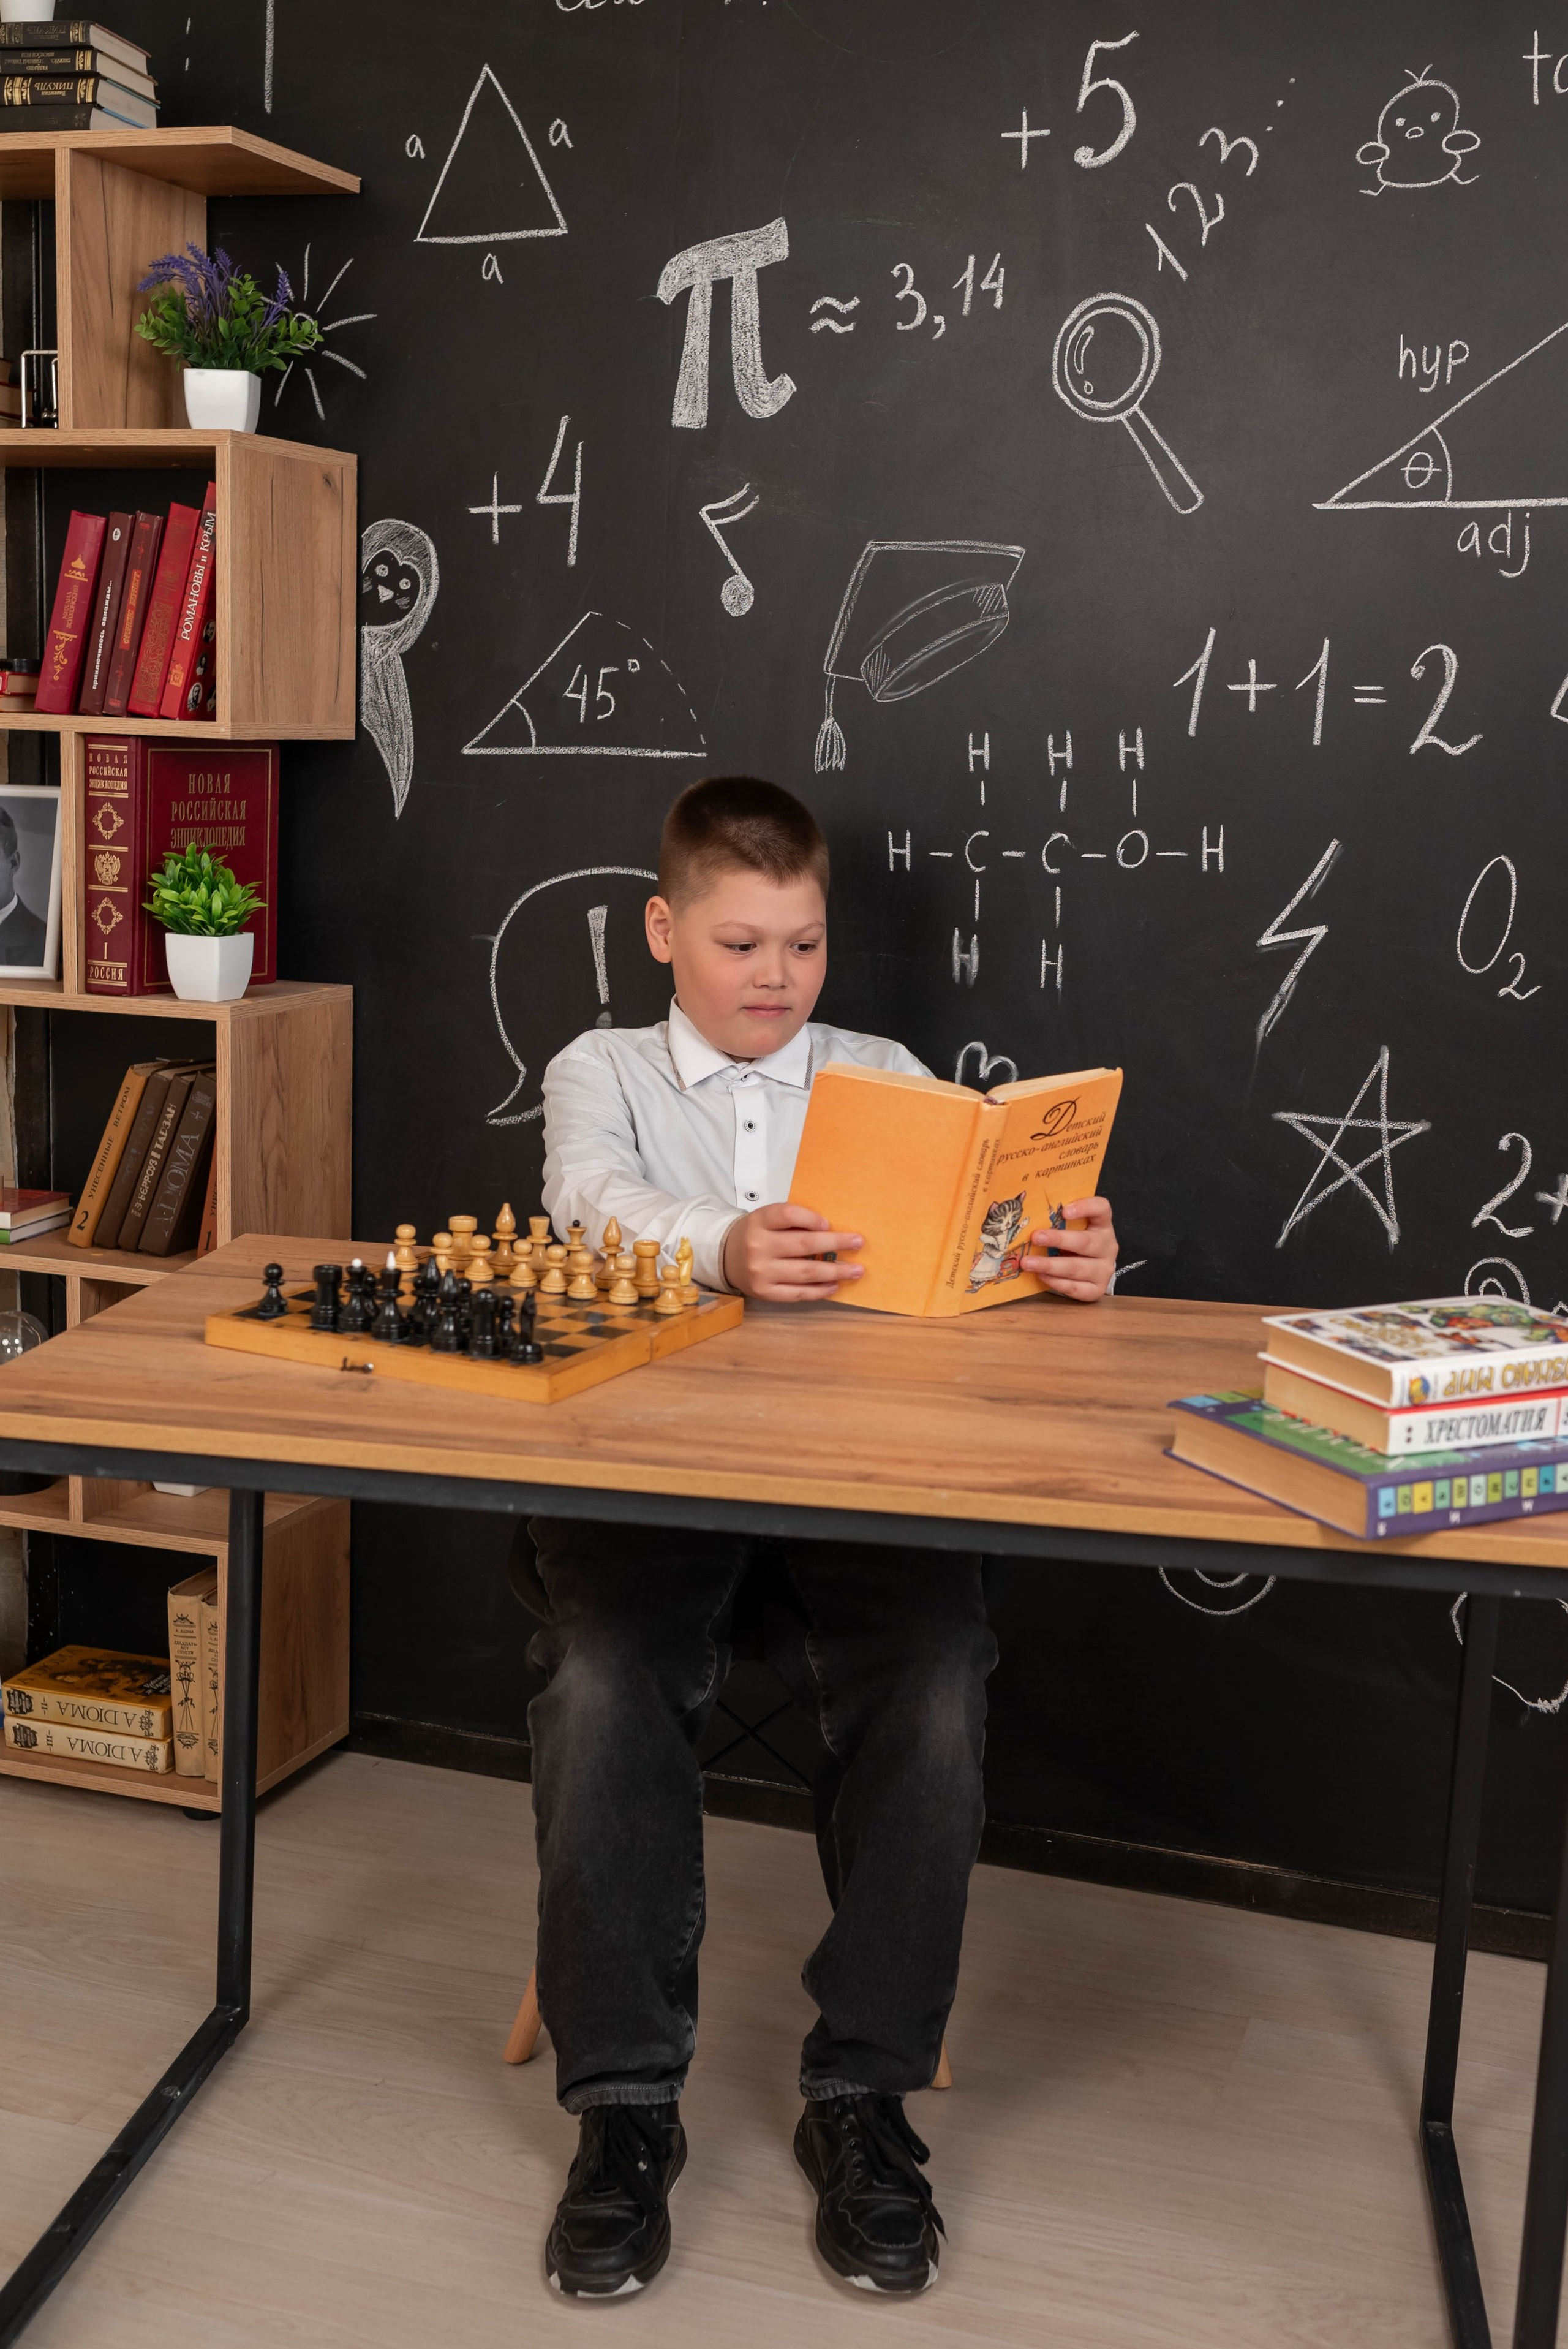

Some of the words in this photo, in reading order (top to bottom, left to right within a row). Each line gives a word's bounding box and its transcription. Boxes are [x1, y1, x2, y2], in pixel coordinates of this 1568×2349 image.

[34, 82, 74, 91] ПИКУЛЬ
[405, 134, 425, 159] a
[548, 118, 573, 148] a
[482, 253, 503, 284] a
[1399, 334, 1469, 392] hyp
[1458, 513, 1529, 577] adj
[181, 564, 206, 641] РОМАНОВЫ
[200, 511, 216, 552] КРЫМ
[92, 629, 105, 690] приключилось
[102, 580, 113, 627] однажды...
[89, 752, 127, 764] НОВАЯ
[89, 766, 127, 777] РОССИЙСКАЯ
[89, 779, 127, 791] ЭНЦИКЛОПЕДИЯ
[189, 773, 230, 794] НОВАЯ
[171, 798, 246, 822] РОССИЙСКАЯ
[171, 826, 246, 850] ЭНЦИКЛОПЕДИЯ
[89, 966, 124, 980] РОССИЯ
[154, 1103, 177, 1151] ТАРЗАН
[1030, 1095, 1106, 1141] Детский
[88, 1135, 115, 1199] УНЕСЕННЫЕ
[113, 1086, 130, 1127] ВЕТРОМ
[997, 1125, 1102, 1165] русско-английский
[1059, 1141, 1099, 1160] словарь
[985, 1138, 1001, 1185] картинках
[1022, 1173, 1030, 1182] в
[1035, 1153, 1096, 1179] картинках
[76, 1210, 89, 1231] 2
[945, 1252, 961, 1289] Детский
[957, 1172, 981, 1250] русско-английский
[977, 1138, 990, 1172] словарь
[203, 1230, 212, 1252] 1
[1444, 1367, 1494, 1397] МИР
[1425, 1407, 1548, 1445] ХРЕСТОМАТИЯ
